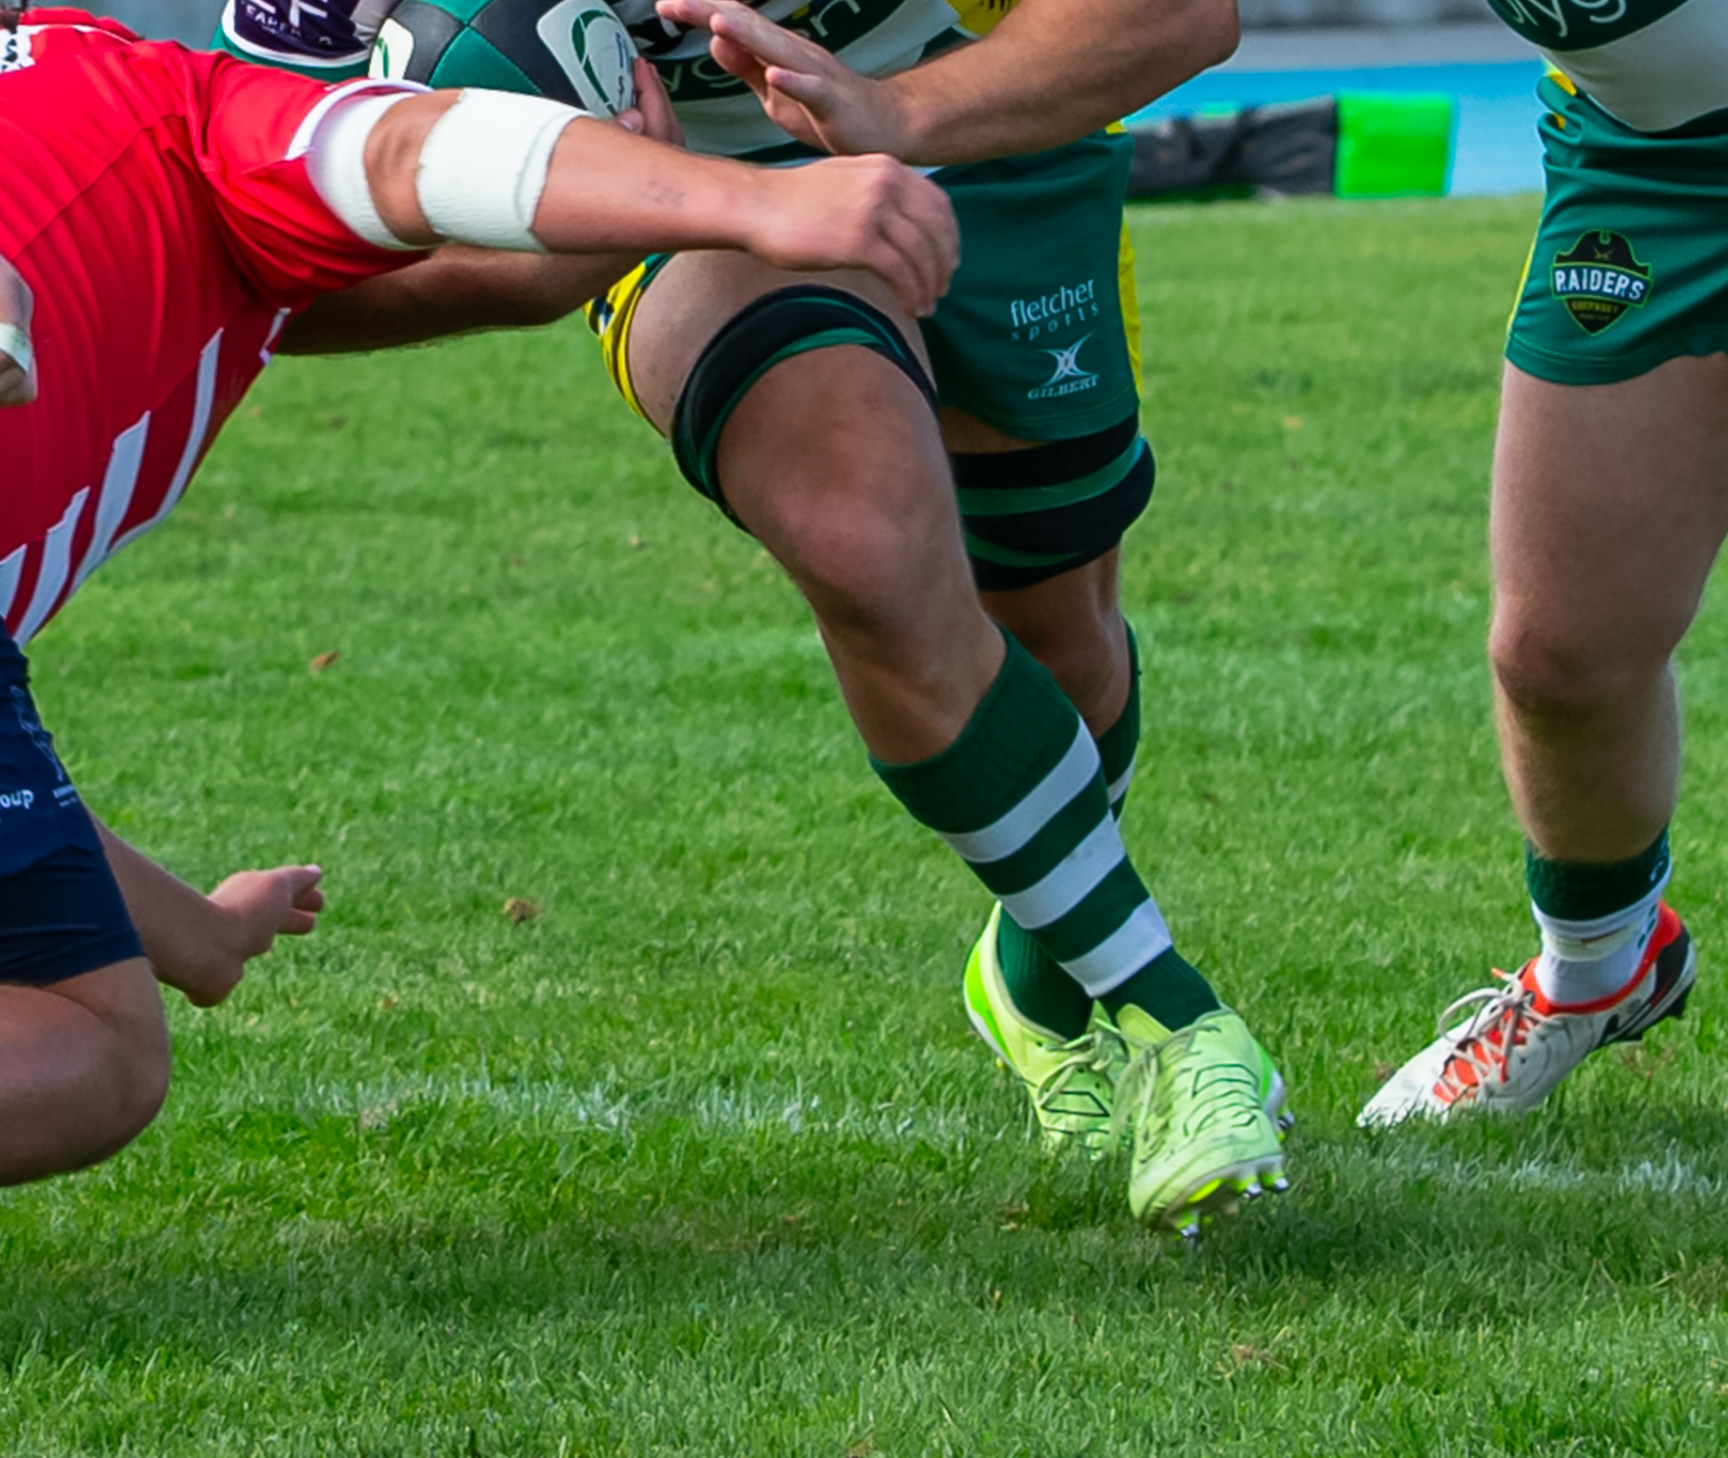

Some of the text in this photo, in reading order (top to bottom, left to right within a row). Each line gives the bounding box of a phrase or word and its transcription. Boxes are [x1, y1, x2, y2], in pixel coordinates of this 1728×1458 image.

[1555, 268, 1645, 300] RAIDERS
[1010, 278, 1094, 327] fletcher
[1027, 373, 1099, 399] GILBERT
